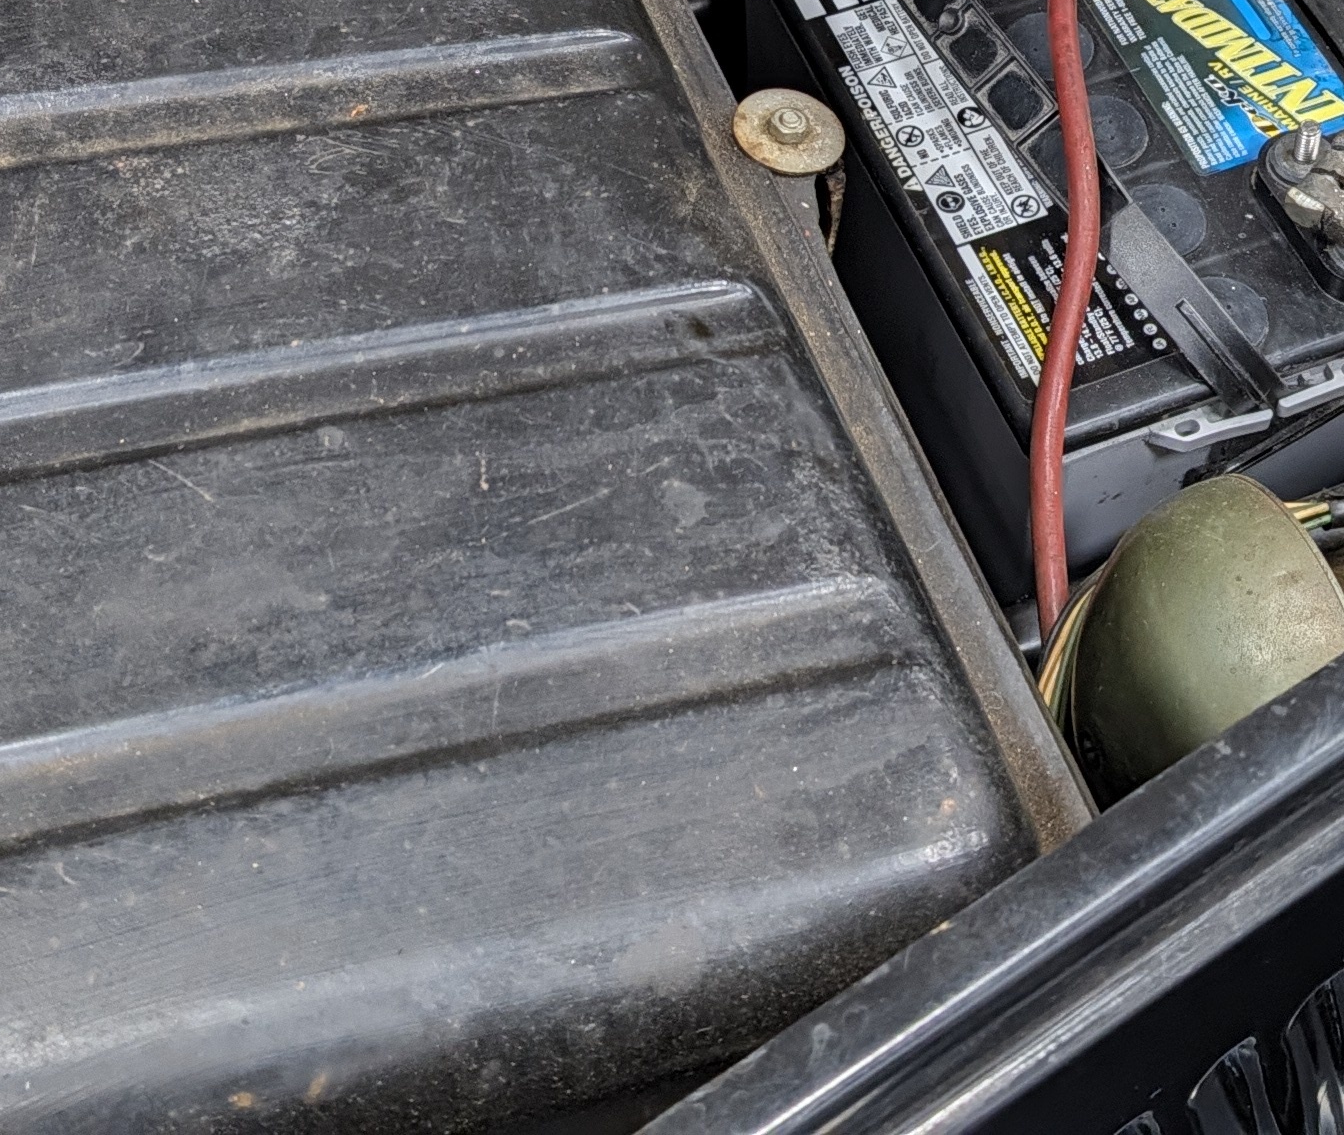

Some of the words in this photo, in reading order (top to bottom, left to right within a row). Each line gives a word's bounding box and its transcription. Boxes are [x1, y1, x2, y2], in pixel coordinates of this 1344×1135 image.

[853, 7, 868, 21] GET
[862, 4, 886, 33] MEDICAL
[872, 1, 891, 20] FAST.
[1123, 11, 1137, 26] FREE
[852, 22, 874, 46] WATER.
[883, 19, 899, 36] HELP
[1111, 9, 1138, 43] WARRANTY
[1131, 24, 1147, 40] TOLL
[836, 32, 853, 50] EYES
[842, 23, 875, 66] IMMEDIATELY
[1115, 32, 1129, 46] FOR
[845, 48, 865, 70] FLUSH
[866, 44, 884, 64] WITH
[903, 70, 915, 81] OR
[911, 64, 930, 87] BURNS.
[1207, 59, 1233, 79] RV
[899, 82, 916, 102] CAUSE
[908, 80, 933, 110] BLINDNESS
[924, 86, 942, 107] SEVERE
[877, 88, 903, 120] SULFURIC
[897, 100, 914, 117] ACID
[909, 101, 923, 113] CAN
[1236, 84, 1299, 130] MARINE
[838, 65, 914, 179] DANGER/POISON
[915, 147, 930, 159] NO
[952, 172, 973, 195] GASES
[960, 163, 986, 195] BLINDNESS
[965, 194, 996, 231] EXPLOSIVE
[979, 194, 998, 215] CAUSE
[988, 191, 1009, 215] INJURY.
[950, 214, 973, 239] SHIELD
[964, 213, 985, 235] EYES.
[991, 213, 1006, 227] CAN
[1002, 214, 1014, 225] OR
[976, 272, 995, 295] VENTS.
[964, 277, 1004, 336] NONSERVICEABLE
[988, 294, 1004, 312] OPEN
[998, 311, 1010, 322] TO
[1004, 321, 1027, 351] ATTEMPT
[1000, 338, 1029, 379] IMPORTANT
[1020, 349, 1035, 365] NOT
[1029, 365, 1041, 375] DO
